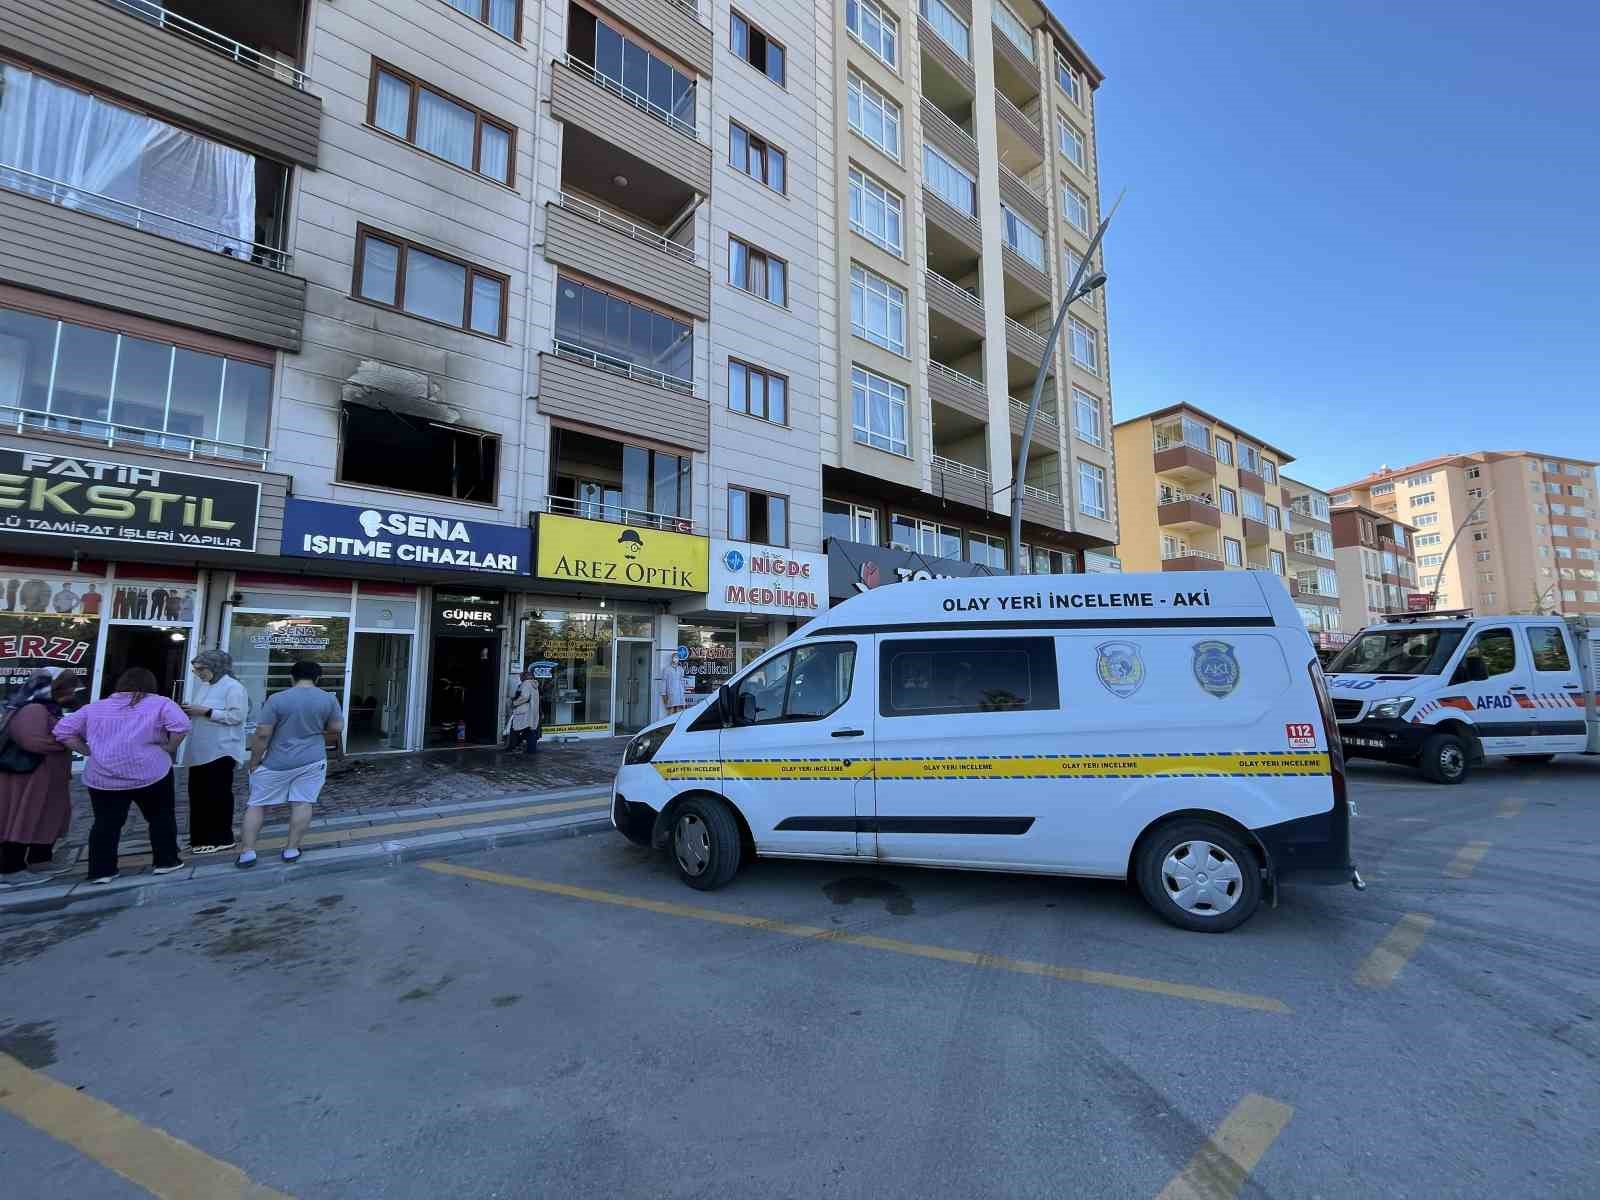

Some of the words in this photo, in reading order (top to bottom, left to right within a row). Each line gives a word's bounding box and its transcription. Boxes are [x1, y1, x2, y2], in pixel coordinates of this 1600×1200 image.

[27, 519, 114, 536] TAMİRAT
[118, 525, 175, 541] İŞLERİ
[178, 533, 241, 547] YAPILIR
[388, 513, 470, 543] SENA
[554, 554, 617, 580] AREZ
[625, 562, 695, 588] OPTİK
[726, 582, 819, 609] MEDİKAL
[942, 597, 991, 613] OLAY
[997, 592, 1042, 610] YERİ
[1049, 591, 1154, 609] İNCELEME
[1172, 588, 1211, 607] AKİ
[442, 608, 492, 621] GÜNER
[1476, 695, 1512, 710] AFAD
[1288, 725, 1312, 737] 112
